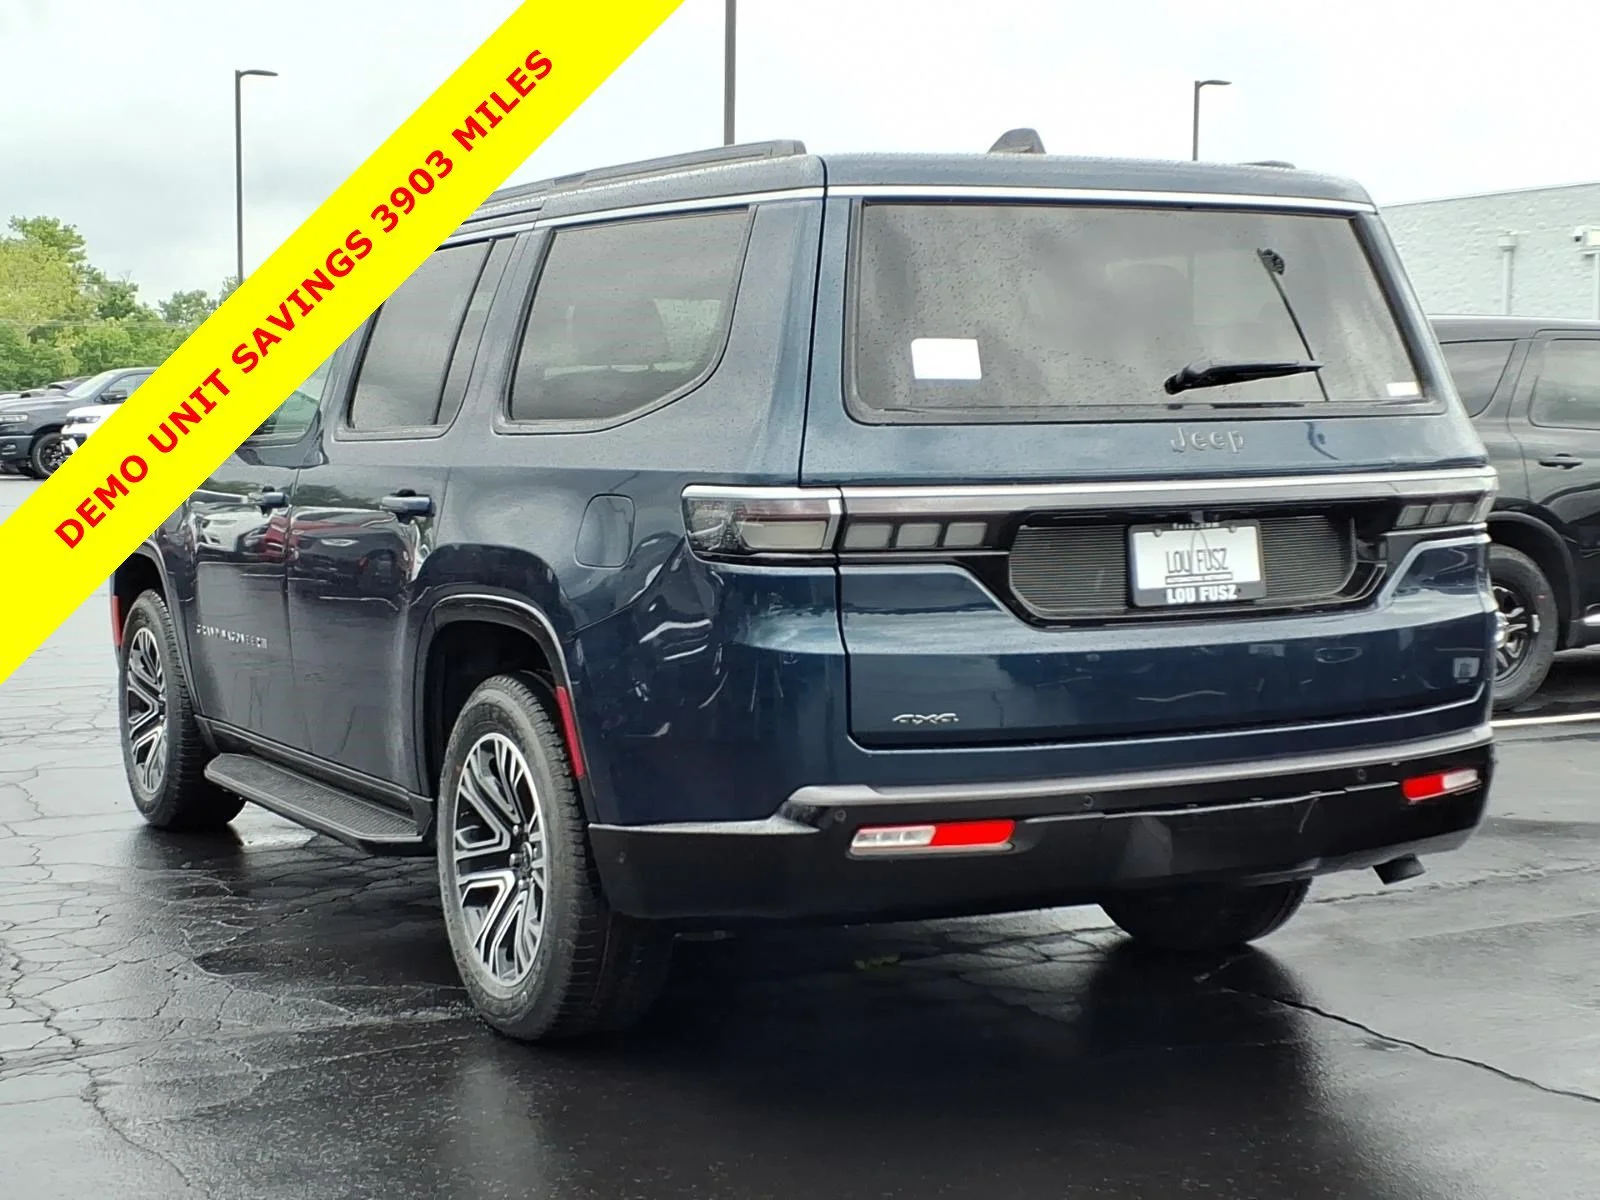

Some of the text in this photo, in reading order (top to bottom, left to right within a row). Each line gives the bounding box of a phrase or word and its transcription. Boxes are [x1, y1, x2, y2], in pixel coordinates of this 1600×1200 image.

[1170, 426, 1245, 455] Jeep
[1166, 547, 1229, 574] LOU FUSZ
[1166, 584, 1238, 604] LOU FUSZ
